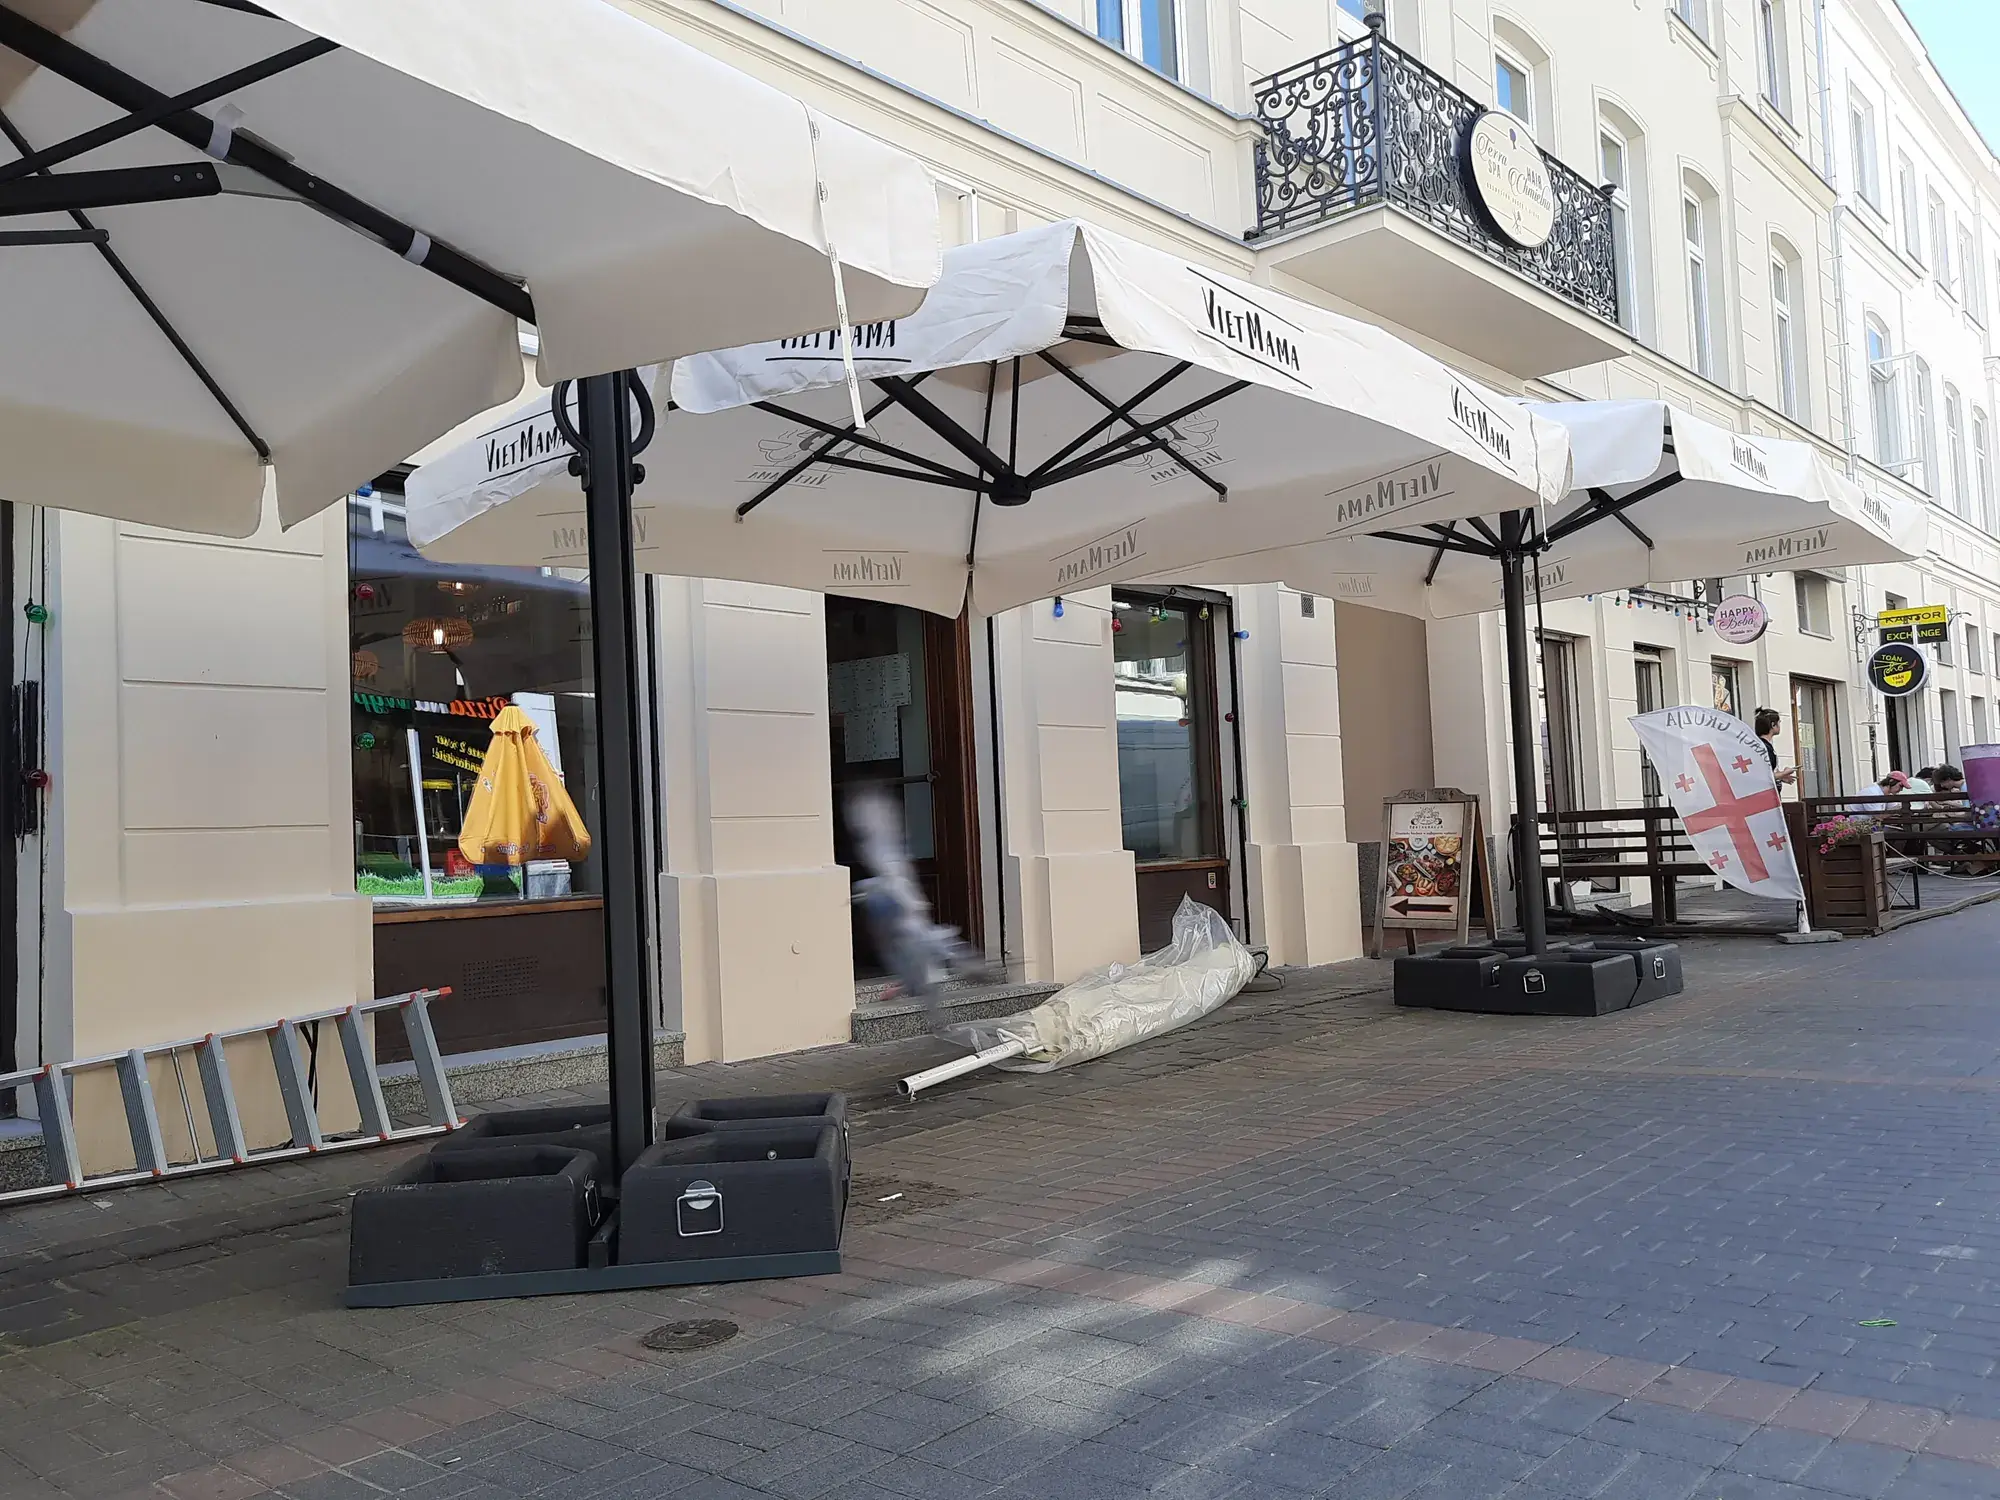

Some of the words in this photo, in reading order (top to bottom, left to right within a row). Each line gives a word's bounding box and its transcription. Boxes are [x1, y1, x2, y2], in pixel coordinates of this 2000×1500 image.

[1475, 132, 1508, 166] Terra
[1488, 160, 1501, 179] SPA
[1526, 166, 1543, 191] HAIR
[1720, 606, 1755, 619] HAPPY
